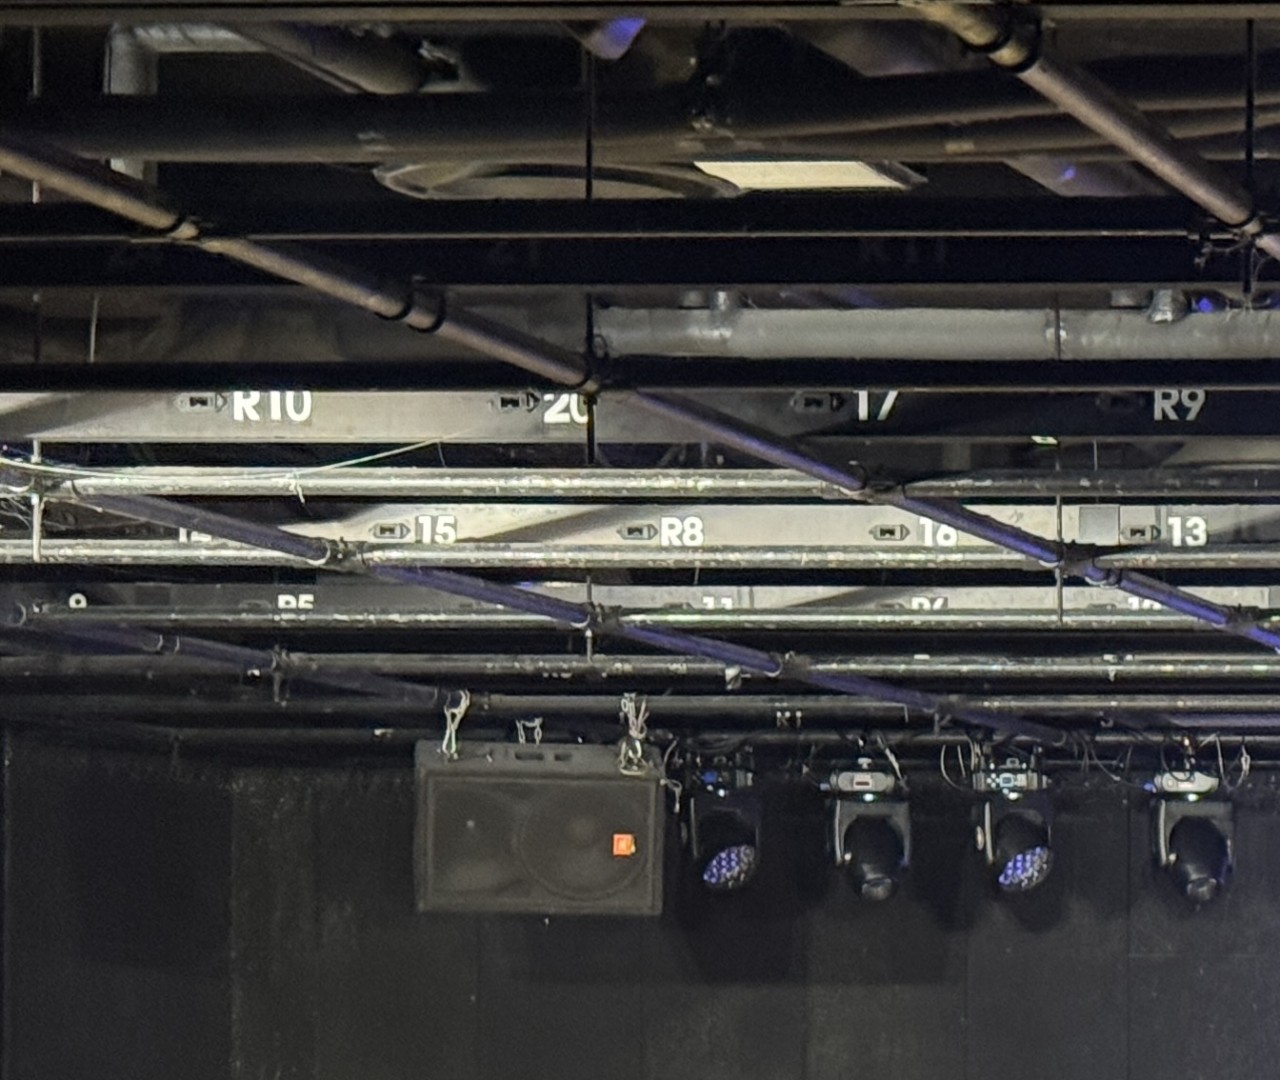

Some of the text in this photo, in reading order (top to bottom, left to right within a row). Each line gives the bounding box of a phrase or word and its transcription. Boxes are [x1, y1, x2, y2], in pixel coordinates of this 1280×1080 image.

[232, 389, 312, 422] R10
[1154, 388, 1205, 421] R9
[418, 515, 467, 544] 15
[660, 514, 704, 547] R8
[1168, 516, 1208, 547] 13
